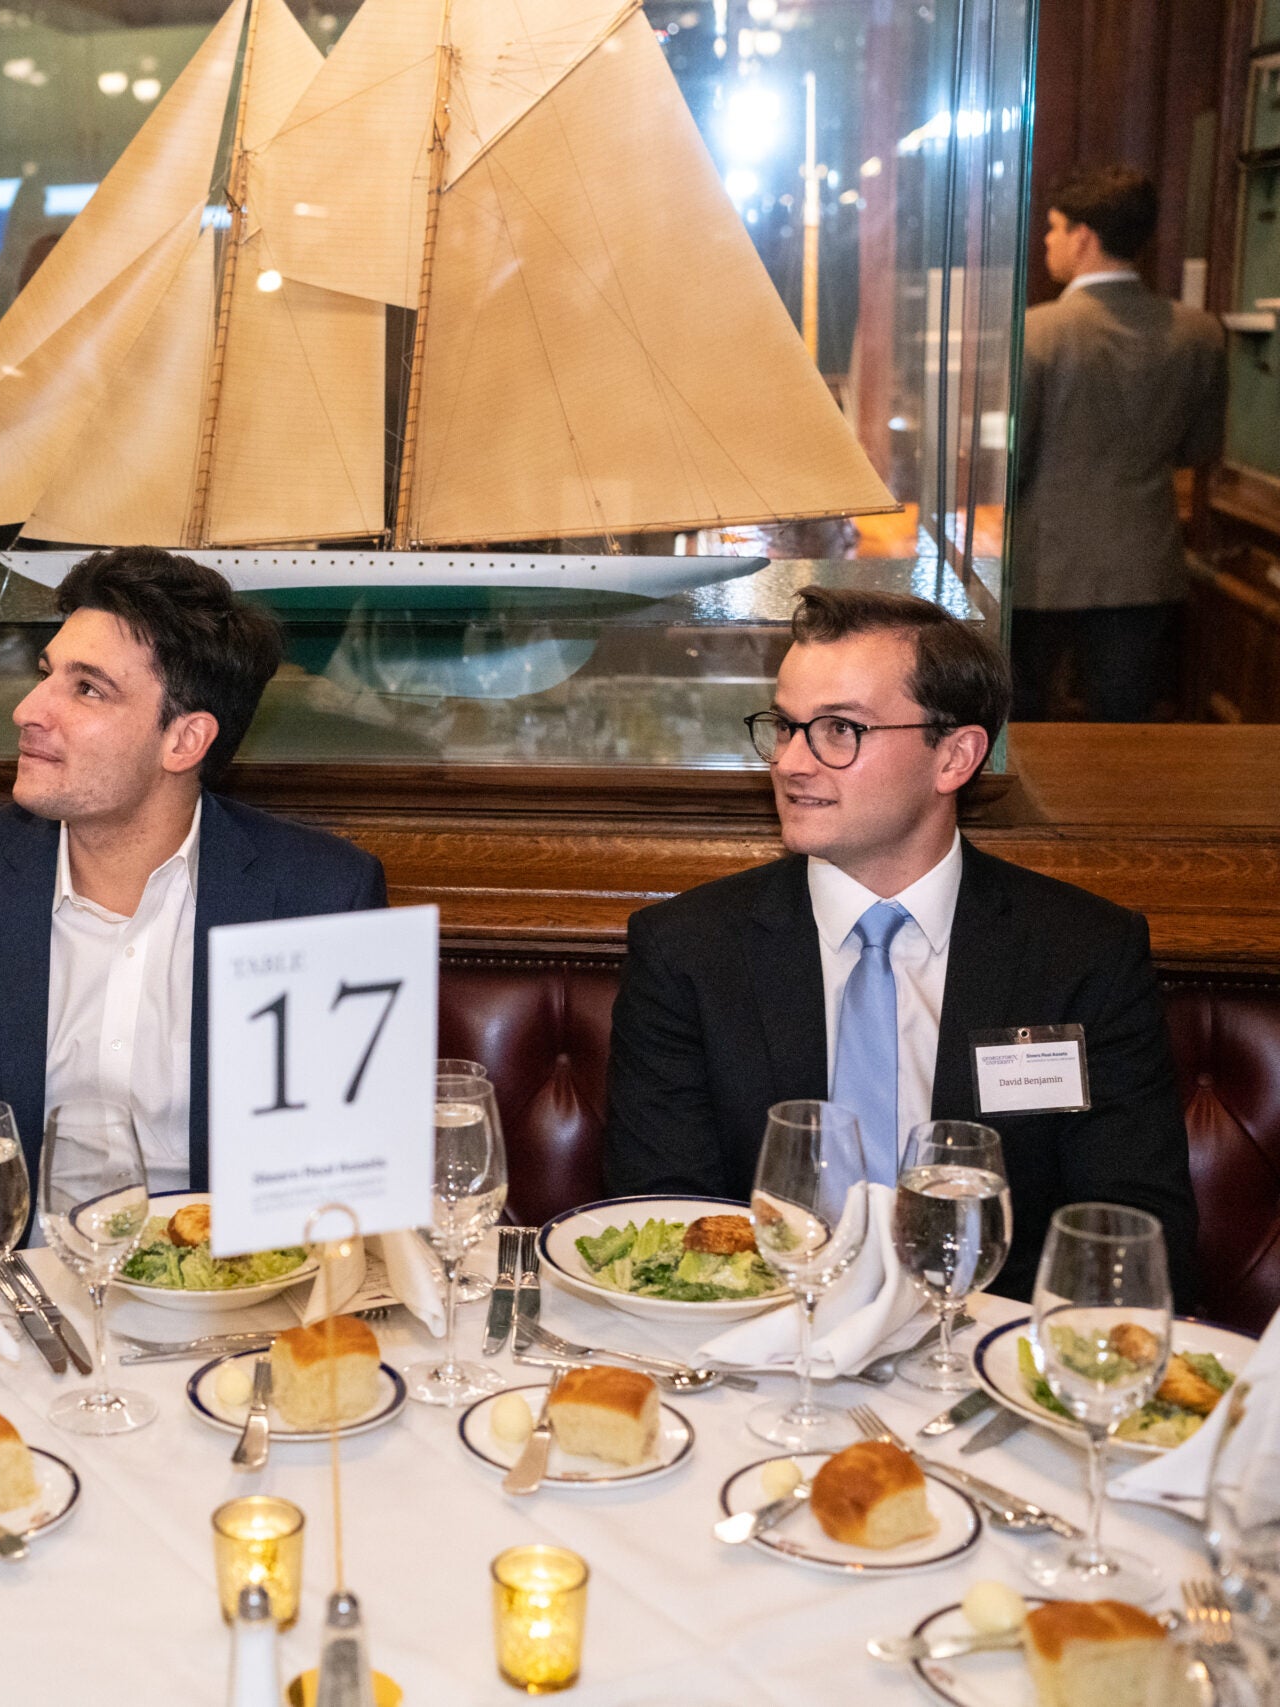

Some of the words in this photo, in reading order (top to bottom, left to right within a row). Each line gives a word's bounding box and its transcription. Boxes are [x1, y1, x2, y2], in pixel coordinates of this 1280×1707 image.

[247, 976, 405, 1116] 17
[999, 1077, 1022, 1087] David
[1023, 1075, 1063, 1086] Benjamin
